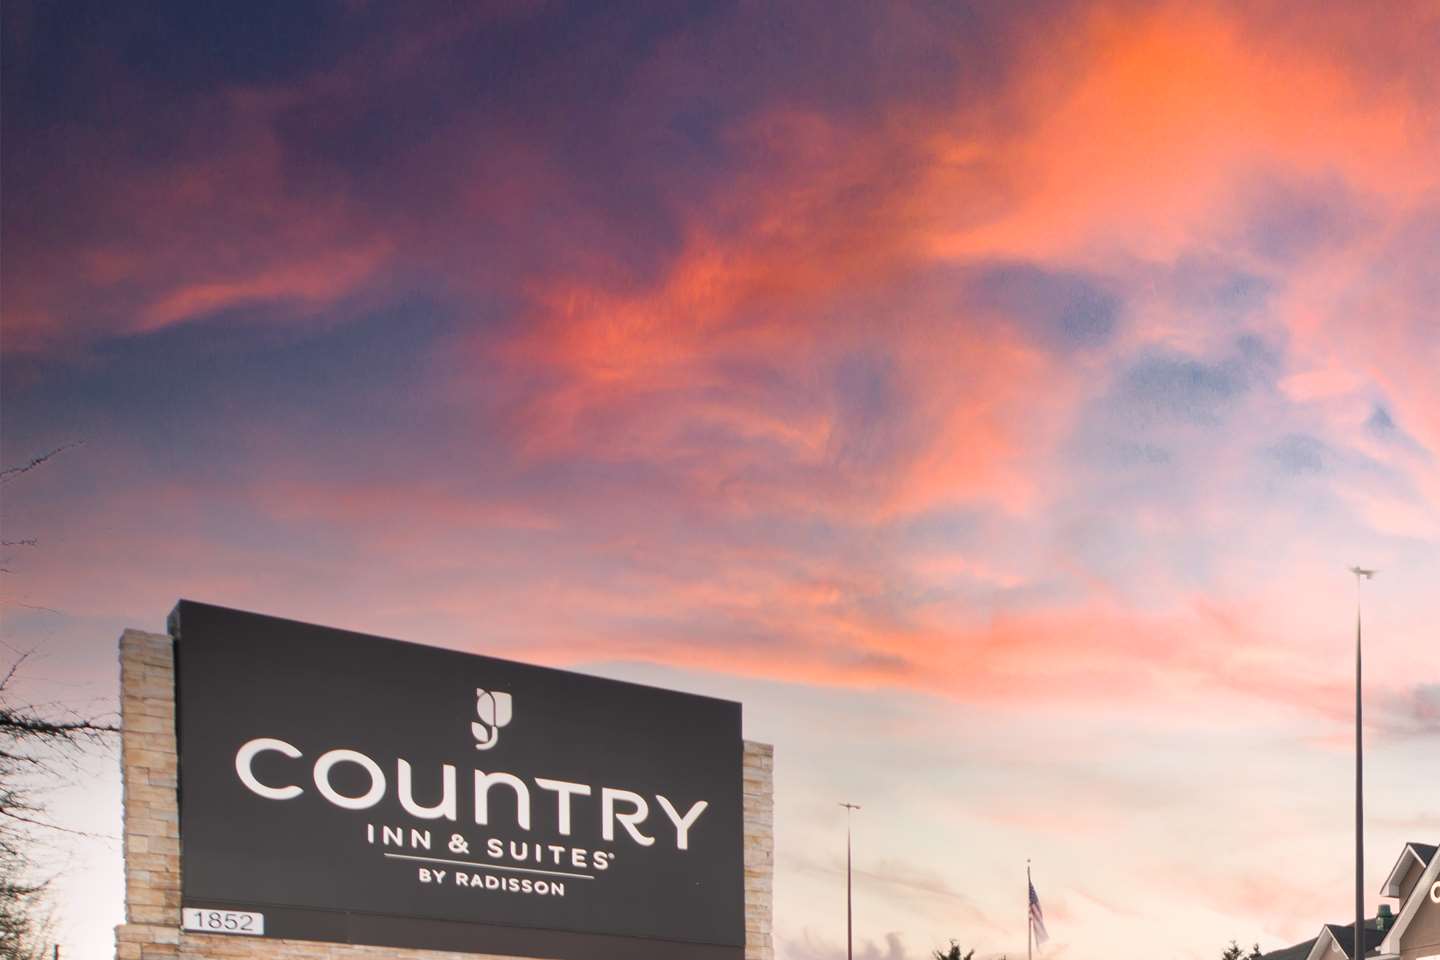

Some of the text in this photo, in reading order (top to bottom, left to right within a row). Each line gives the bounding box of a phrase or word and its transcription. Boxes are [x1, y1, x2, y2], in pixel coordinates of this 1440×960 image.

[367, 823, 431, 850] INN
[448, 833, 470, 854] &
[418, 867, 565, 897] BY RADISSON
[194, 911, 254, 931] 1852
